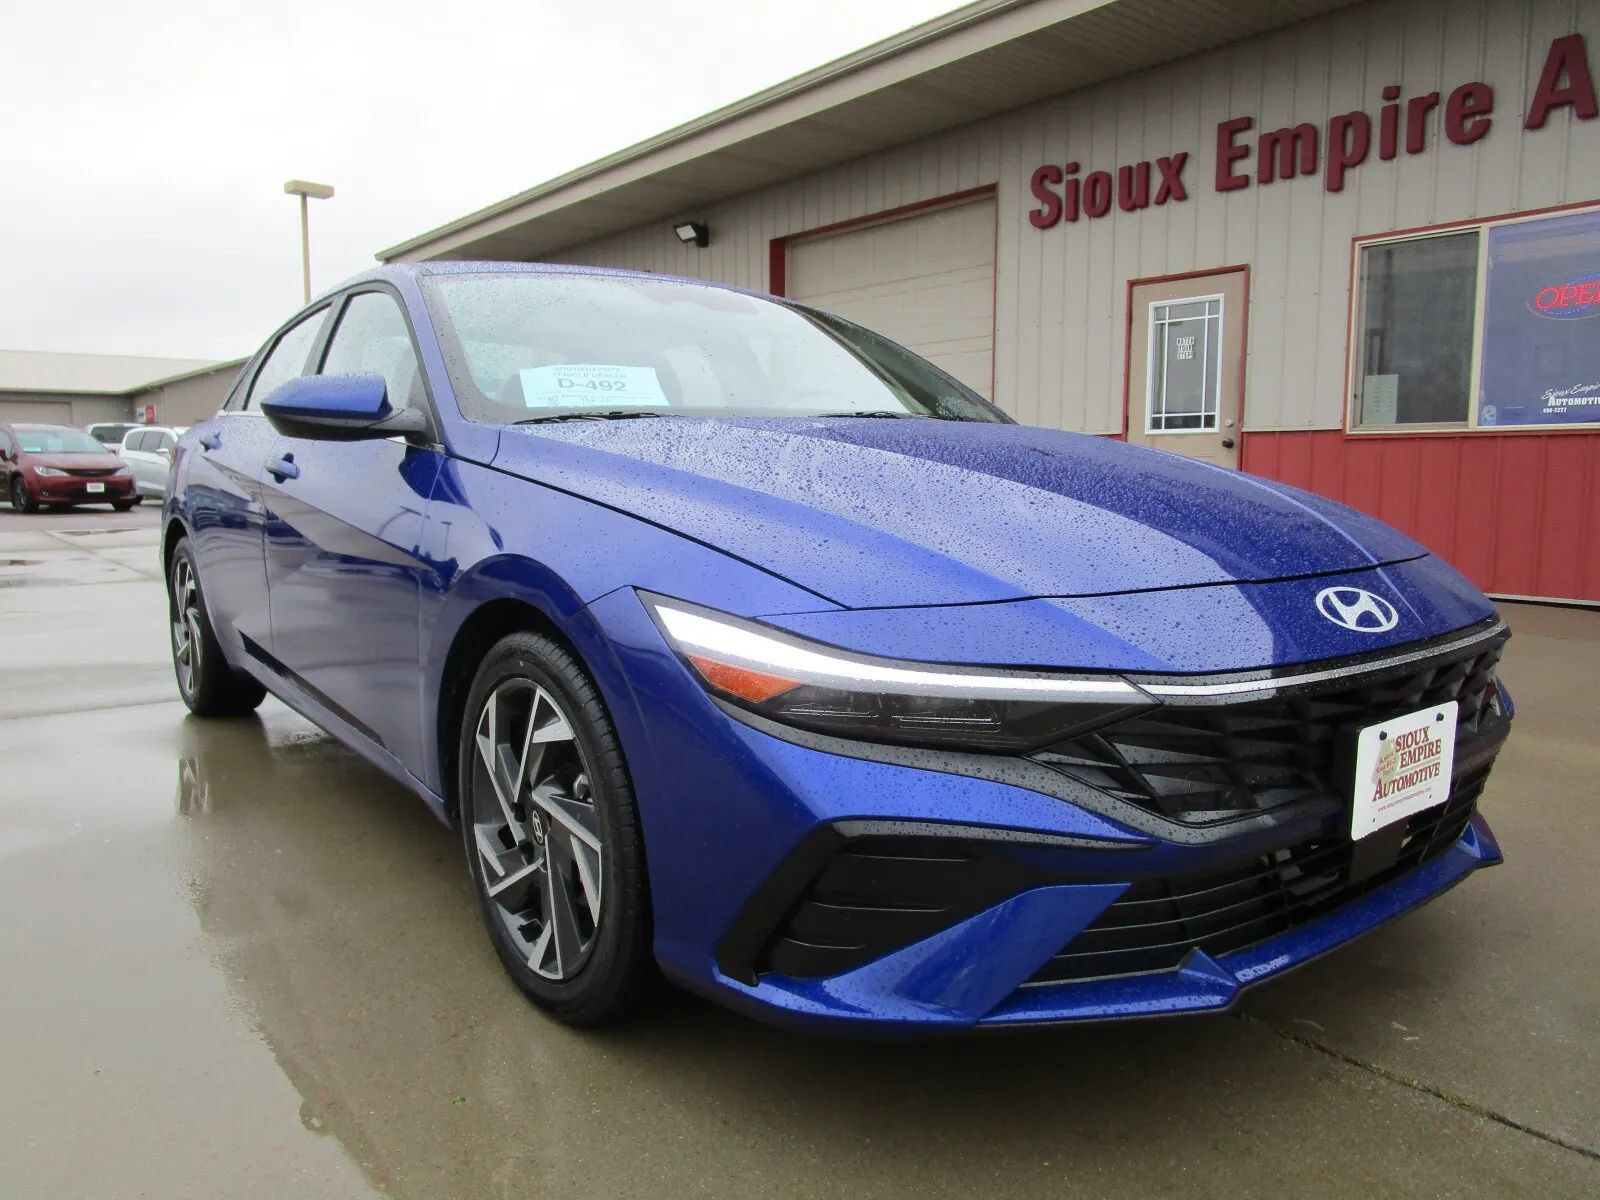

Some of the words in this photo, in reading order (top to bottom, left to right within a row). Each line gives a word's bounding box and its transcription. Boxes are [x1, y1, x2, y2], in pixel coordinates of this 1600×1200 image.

[1029, 153, 1188, 229] Sioux
[1215, 81, 1493, 192] Empire
[557, 378, 629, 392] D-492
[1395, 726, 1430, 752] SIOUX
[1400, 738, 1441, 768] EMPIRE
[1372, 762, 1440, 801] AUTOMOTIVE
